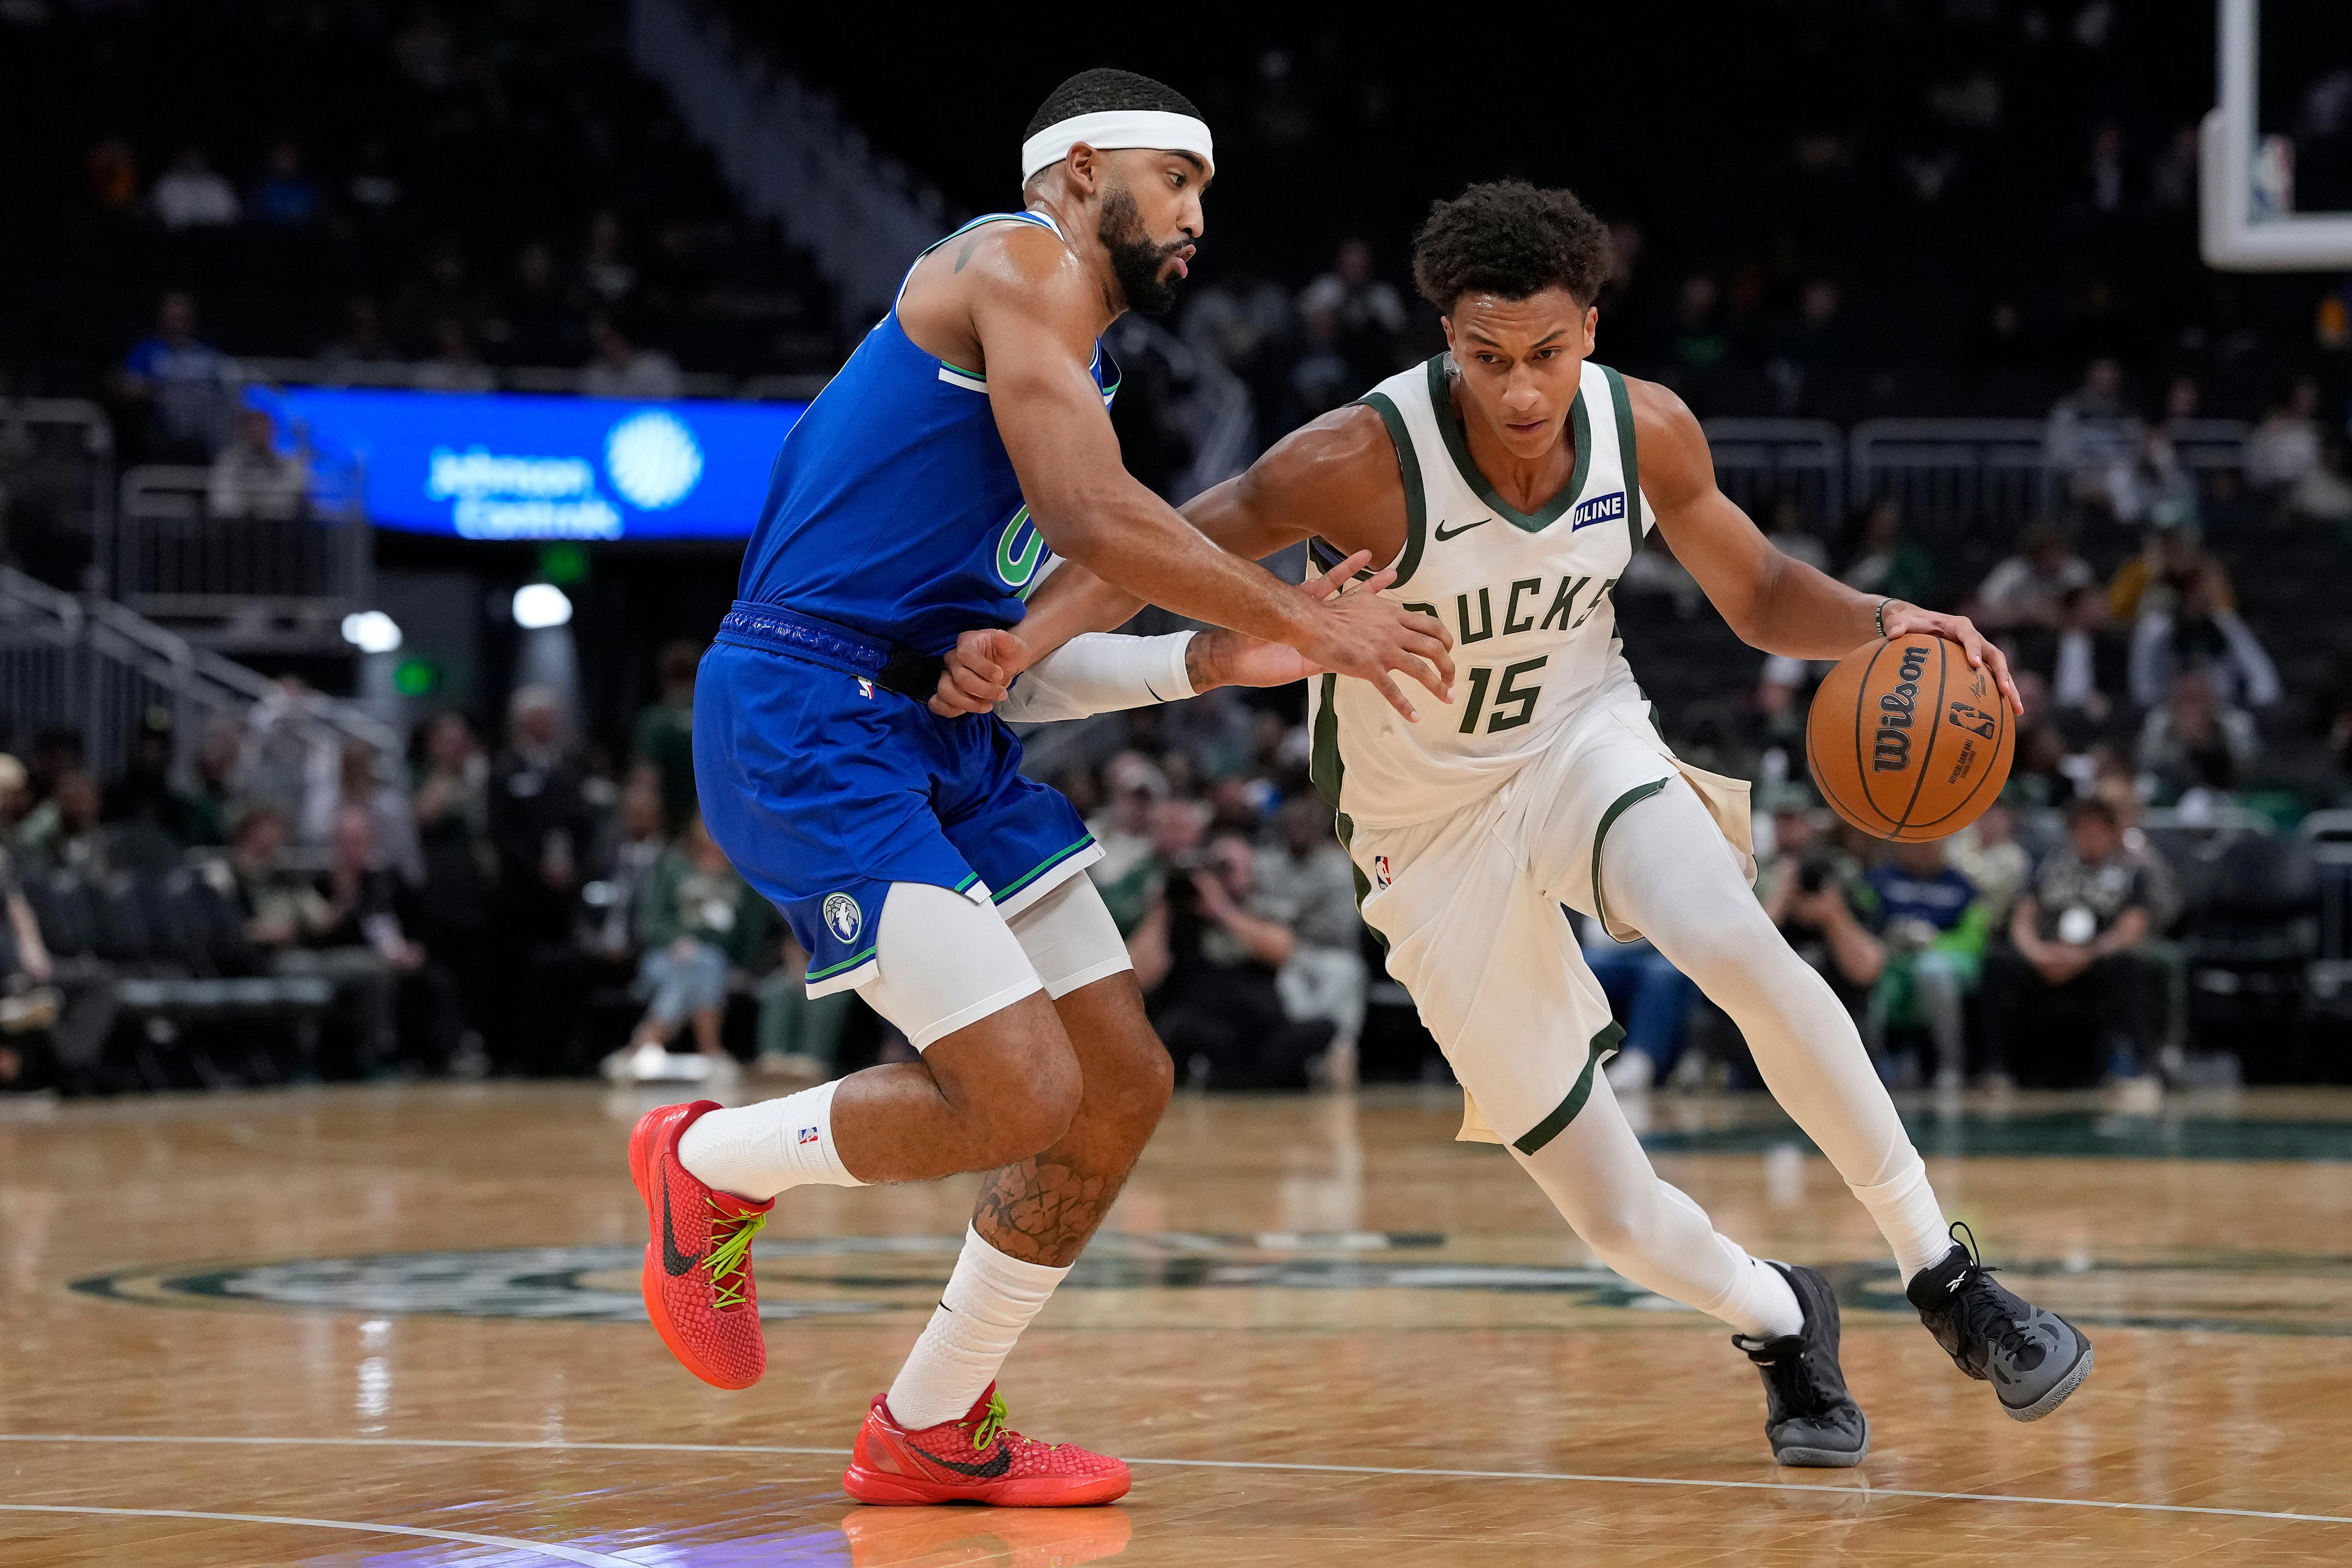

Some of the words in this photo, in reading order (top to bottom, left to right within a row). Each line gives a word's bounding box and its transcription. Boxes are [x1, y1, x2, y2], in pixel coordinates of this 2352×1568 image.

[1575, 497, 1621, 526] ULINE
[1458, 655, 1548, 734] 15
[1873, 646, 1931, 774] Wilson
[1948, 764, 1963, 784] OFFICIAL
[1958, 750, 1968, 765] GAME
[1963, 739, 1973, 751] BALL
